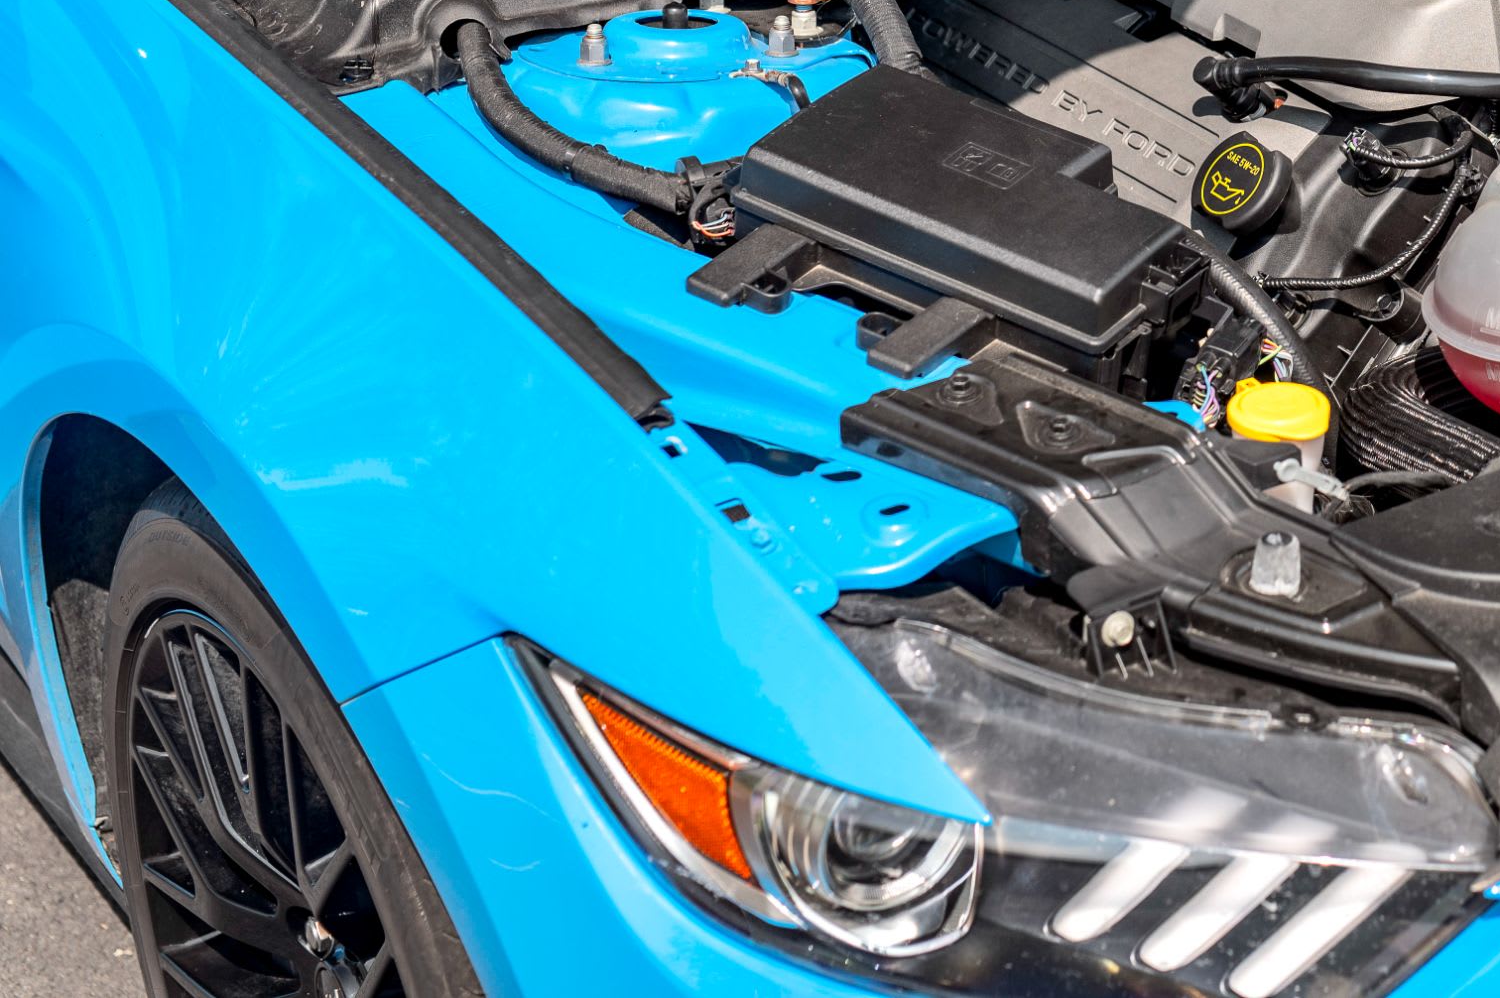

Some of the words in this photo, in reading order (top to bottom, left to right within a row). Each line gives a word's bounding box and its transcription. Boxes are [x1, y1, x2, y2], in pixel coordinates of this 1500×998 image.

[1051, 89, 1103, 123] BY
[1102, 117, 1197, 177] FORD
[1226, 151, 1241, 165] SAE
[1238, 155, 1261, 177] 5W-20
